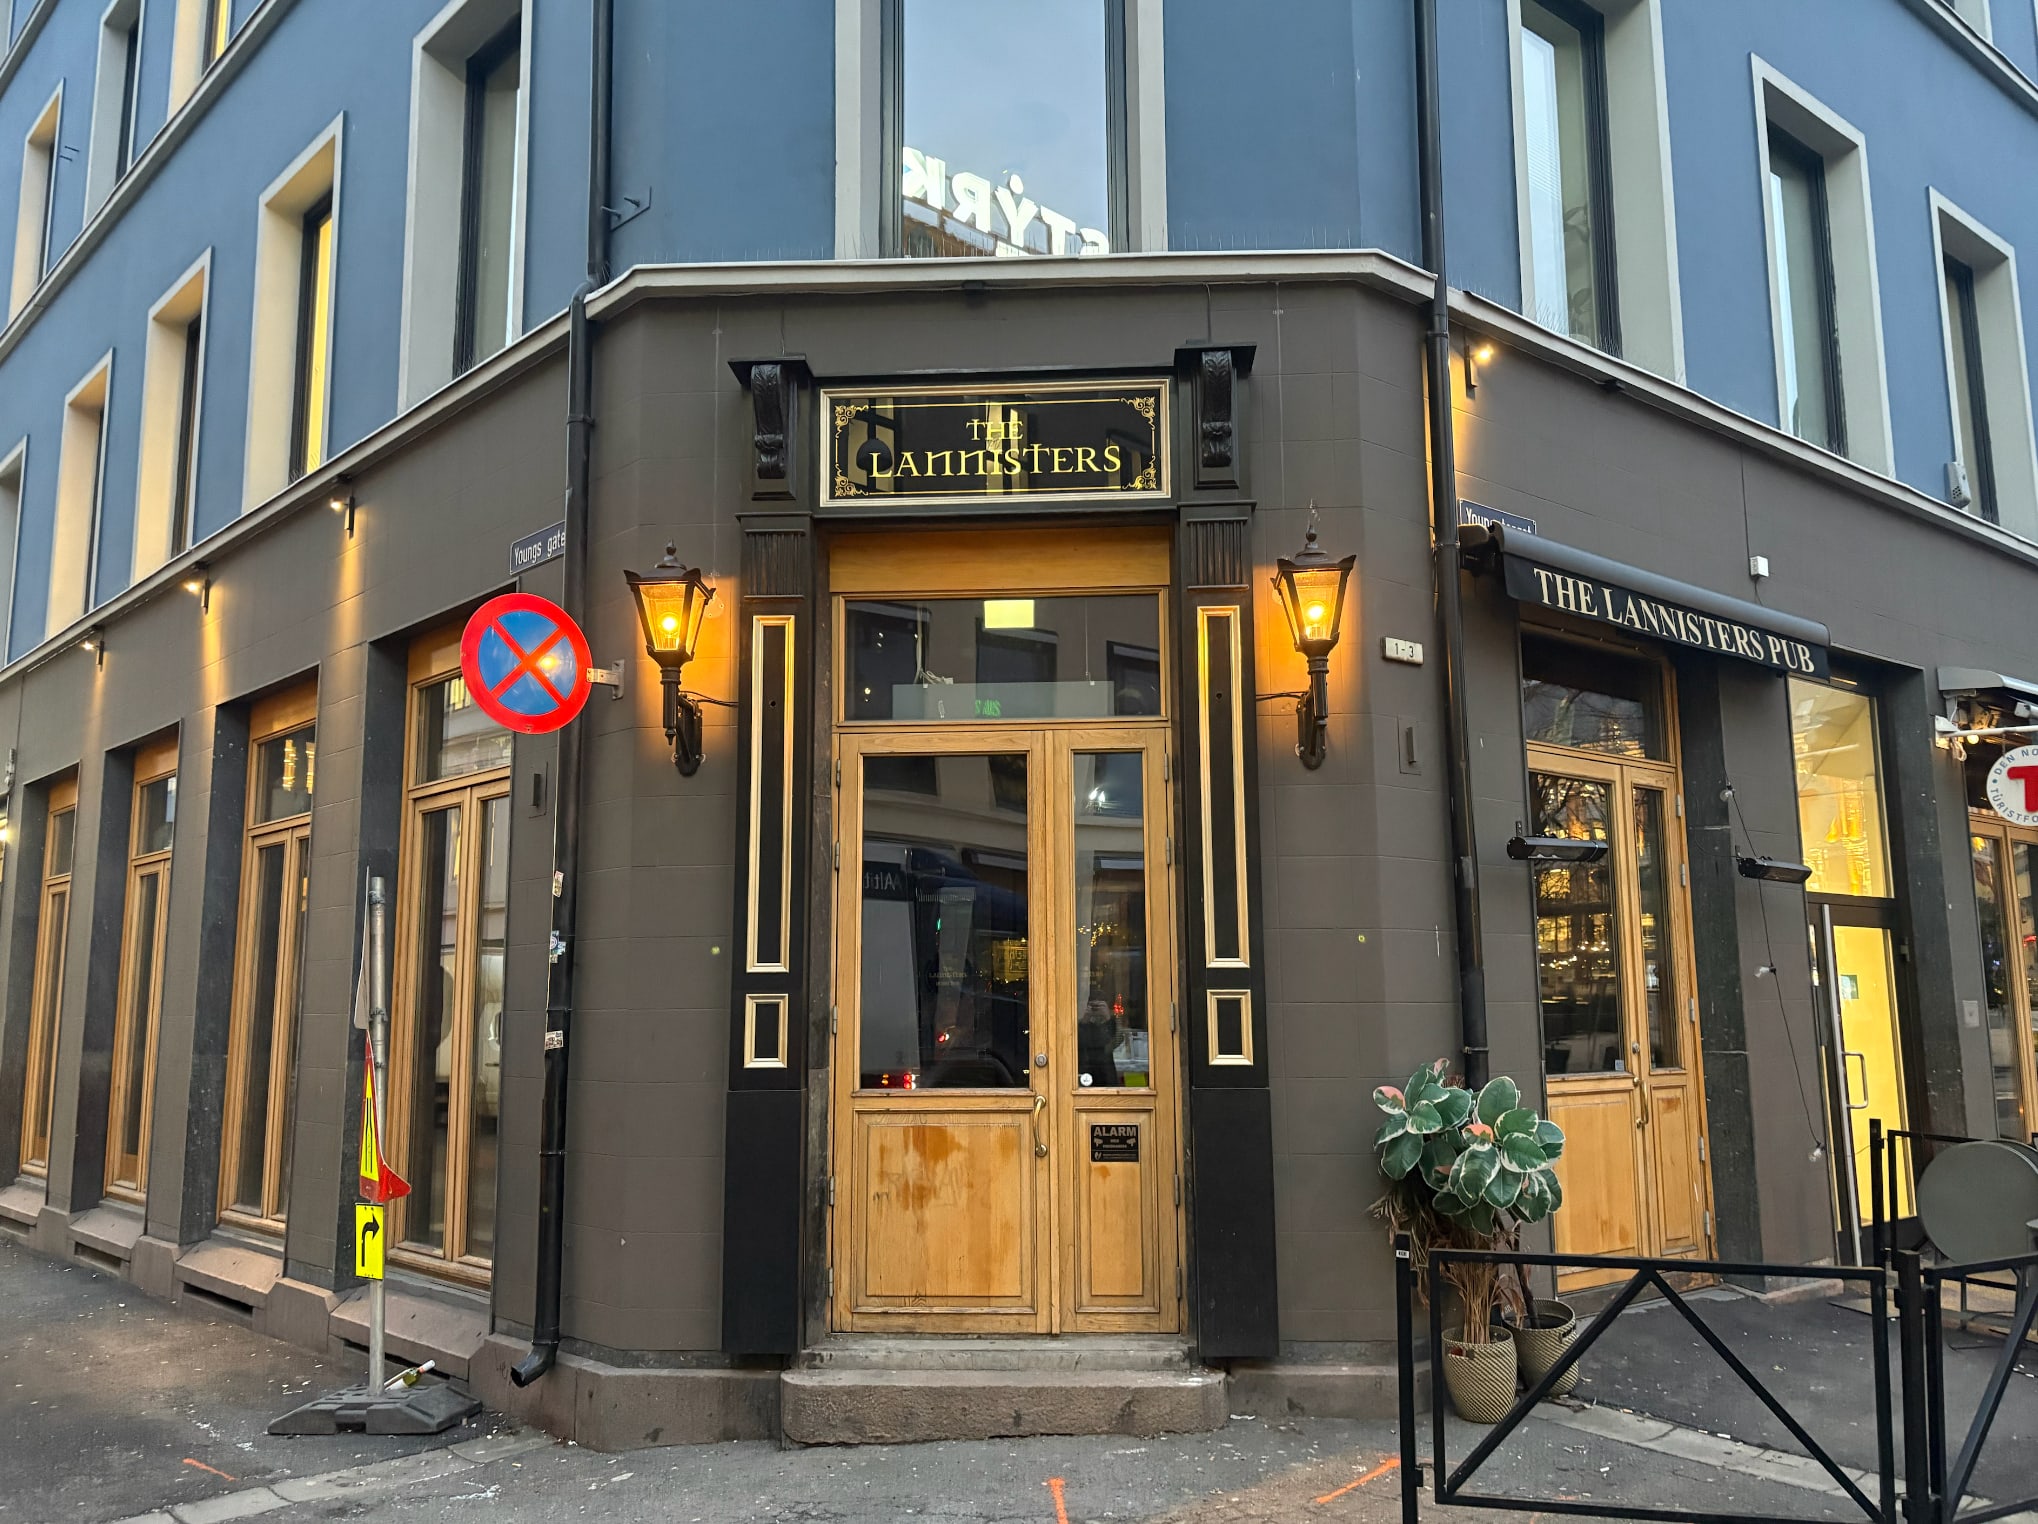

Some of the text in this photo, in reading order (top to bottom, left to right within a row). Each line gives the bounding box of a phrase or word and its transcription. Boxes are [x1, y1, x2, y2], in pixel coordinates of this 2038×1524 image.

[966, 418, 1023, 440] THE
[514, 530, 565, 567] Youngs gate
[1533, 567, 1815, 673] THE LANNISTERS PUB
[1994, 755, 2015, 775] DEN
[1093, 1126, 1137, 1137] ALARM
